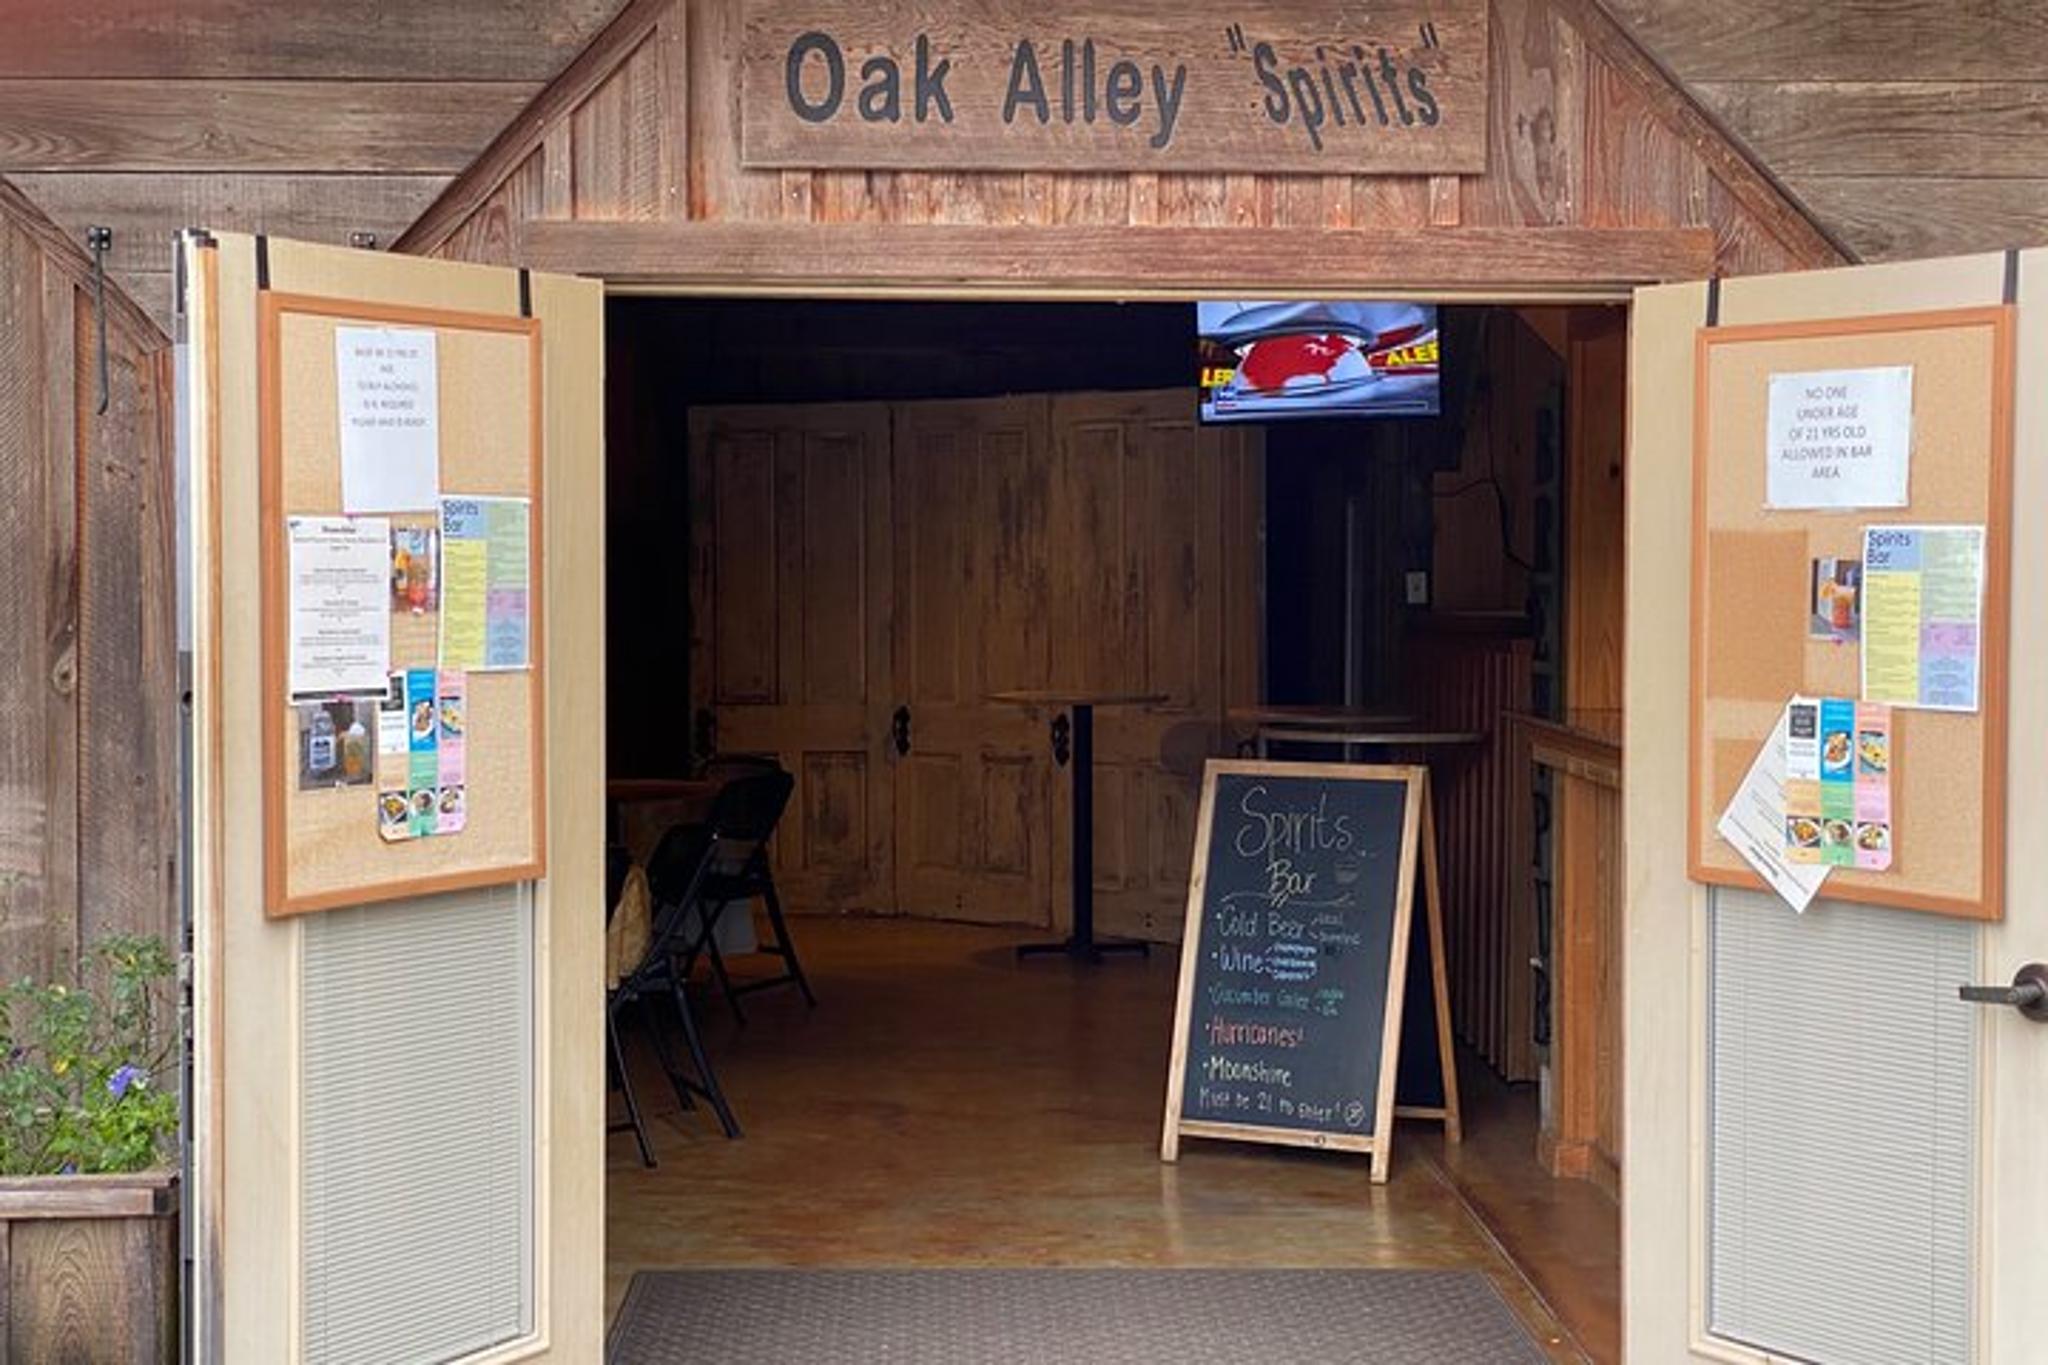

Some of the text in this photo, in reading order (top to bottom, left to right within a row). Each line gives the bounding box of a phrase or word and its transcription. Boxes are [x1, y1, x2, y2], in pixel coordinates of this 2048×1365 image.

[785, 22, 1441, 151] Oak Alley "Spirits"
[1805, 385, 1847, 400] NO ONE
[1797, 403, 1859, 421] UNDER AGE
[1788, 425, 1866, 441] OF 21 YRS OLD
[1781, 444, 1872, 461] ALLOWED IN BAR
[1811, 466, 1841, 479] AREA
[443, 500, 479, 518] Spirits
[443, 517, 464, 532] Bar
[1868, 529, 1912, 548] Spirits
[1867, 548, 1891, 564] Bar
[1235, 785, 1354, 862] Spirits
[1266, 858, 1316, 895] Bar
[1218, 904, 1259, 937] Cold
[1267, 911, 1305, 939] Beer
[1219, 943, 1263, 974] Wine
[1209, 1056, 1291, 1087] Moonshine
[1257, 1091, 1273, 1112] 21
